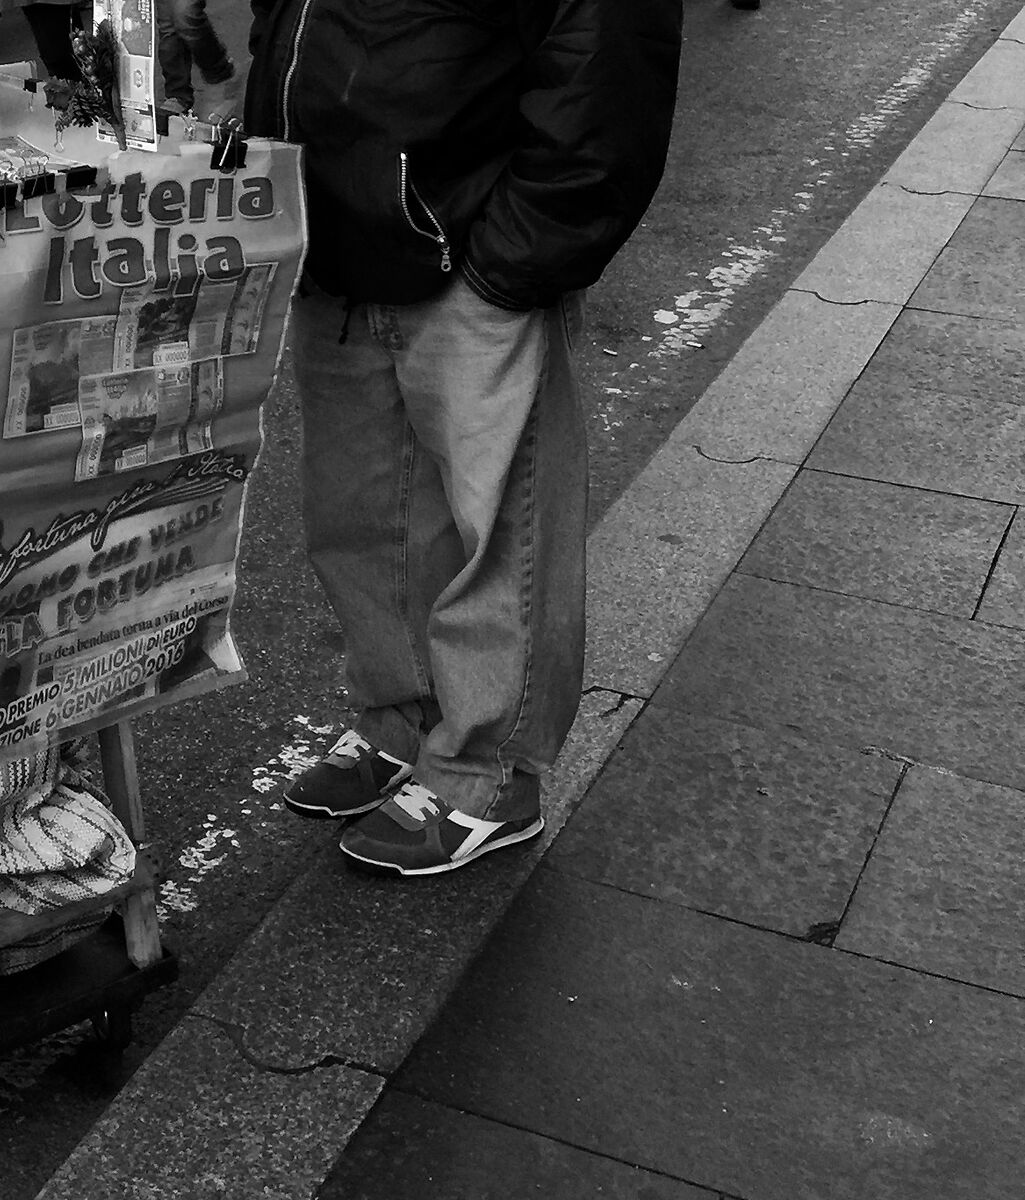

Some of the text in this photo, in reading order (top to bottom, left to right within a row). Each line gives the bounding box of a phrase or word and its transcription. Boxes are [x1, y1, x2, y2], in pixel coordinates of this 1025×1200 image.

[4, 172, 274, 234] Lotteria
[43, 227, 245, 305] Italia
[148, 496, 224, 550] VENDE
[57, 544, 195, 629] FORTUNA
[7, 684, 60, 723] PREMIO
[63, 672, 75, 694] 5
[80, 641, 143, 685] MILIONI
[145, 634, 160, 652] DI
[162, 616, 196, 644] EURO
[38, 650, 51, 665] La
[77, 629, 120, 652] bendata
[122, 619, 152, 638] torna
[154, 616, 161, 627] a
[163, 609, 179, 624] via
[182, 602, 196, 618] del
[46, 707, 58, 728] 6
[61, 669, 143, 719] GENNAIO
[146, 642, 185, 677] 2016
